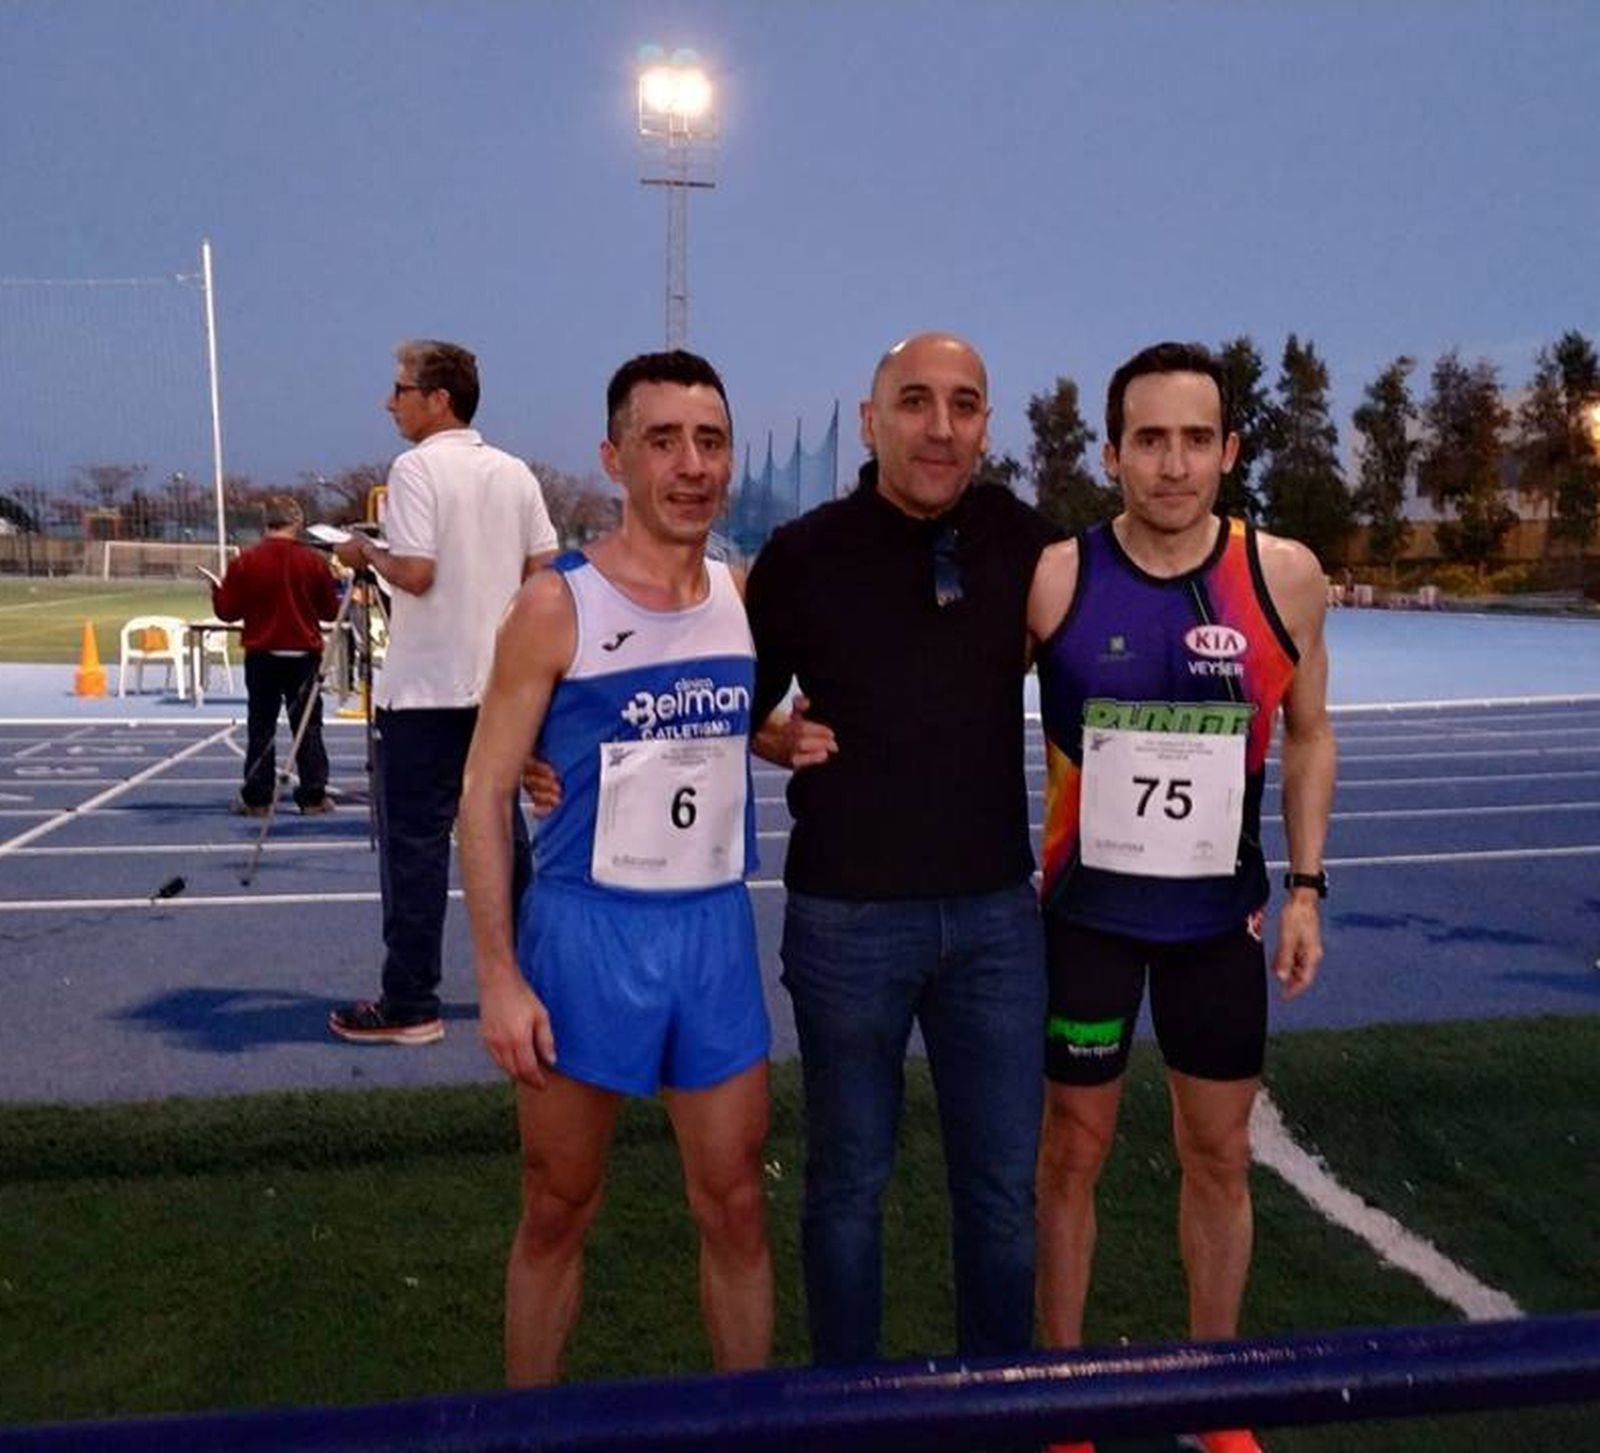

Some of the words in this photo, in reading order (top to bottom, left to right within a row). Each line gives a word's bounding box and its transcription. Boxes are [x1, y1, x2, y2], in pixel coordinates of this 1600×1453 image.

[1194, 631, 1239, 650] KIA
[671, 786, 697, 829] 6
[1133, 775, 1193, 820] 75
